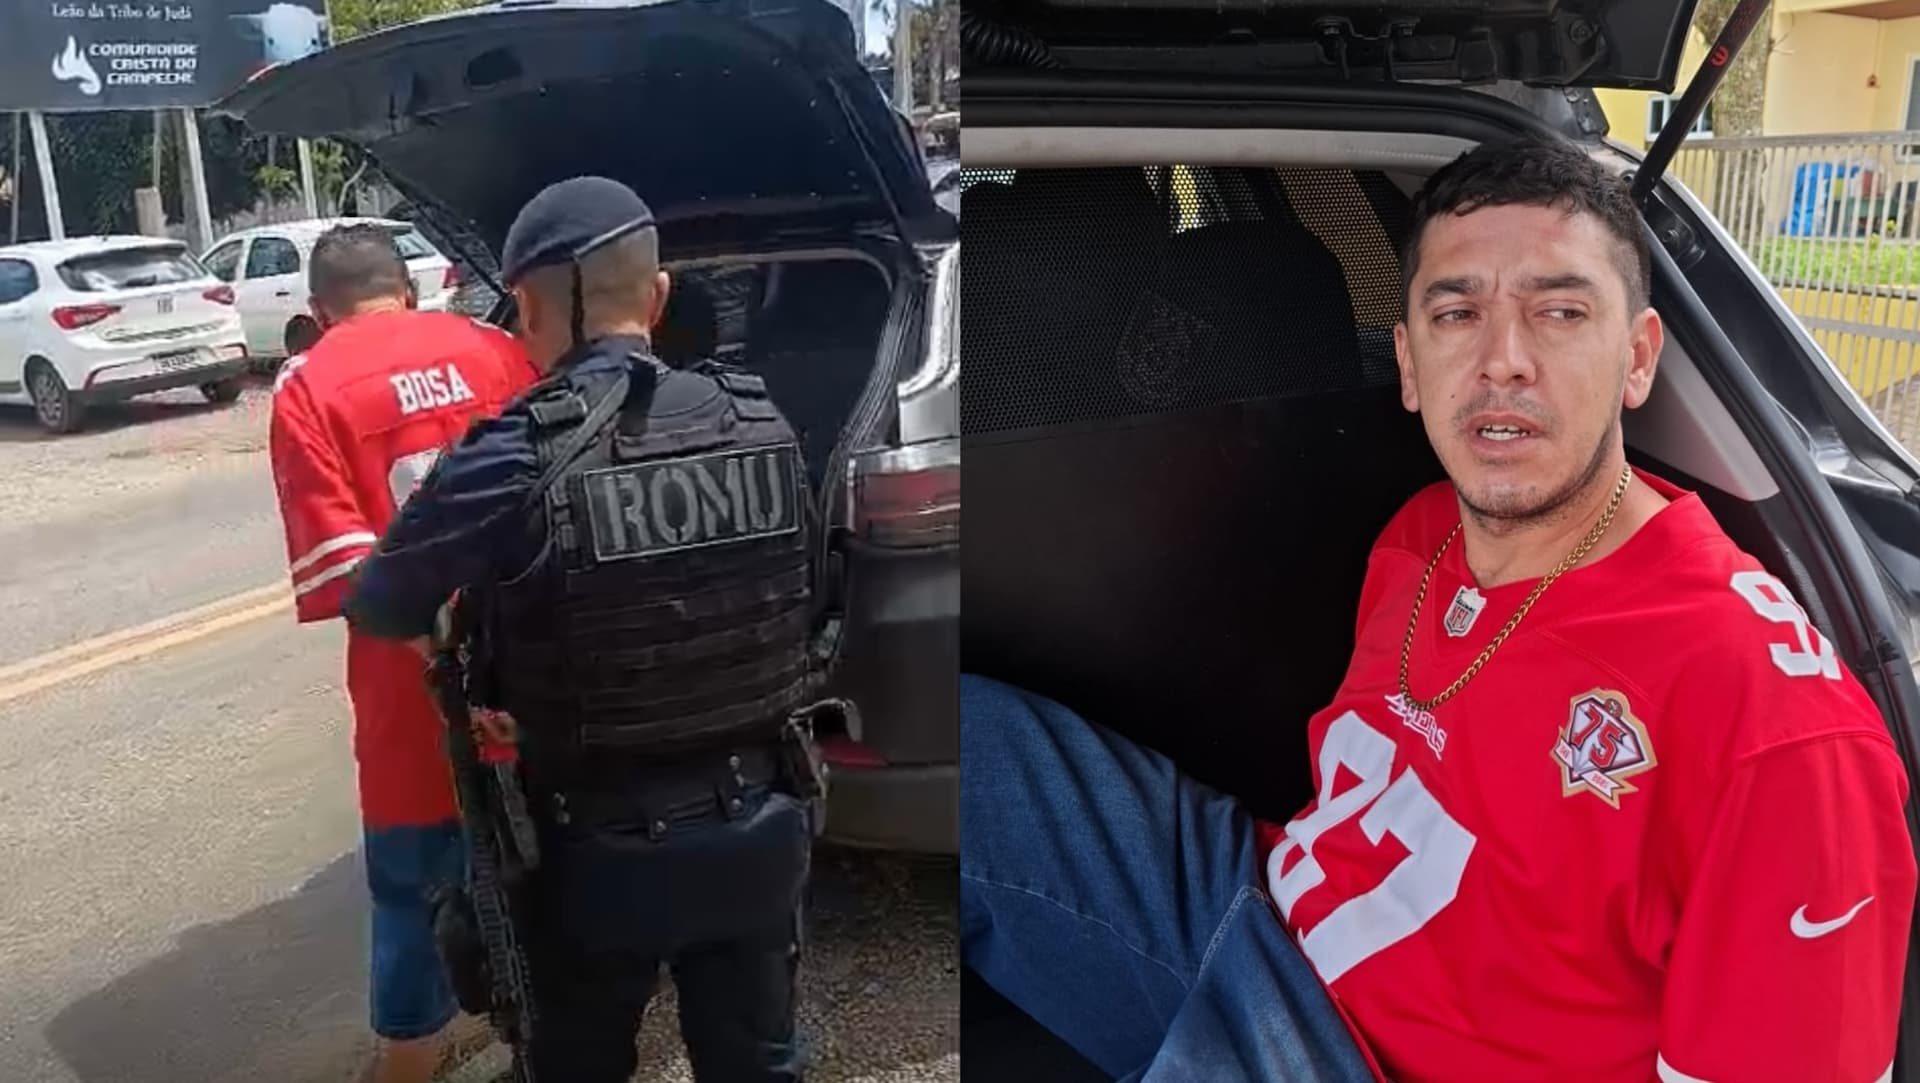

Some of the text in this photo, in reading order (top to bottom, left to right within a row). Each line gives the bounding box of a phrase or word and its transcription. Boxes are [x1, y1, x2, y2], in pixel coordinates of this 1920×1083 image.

[52, 3, 192, 21] Leão da Tribo de Judá
[90, 43, 198, 56] COMUNIDADE
[175, 58, 197, 70] DO
[107, 73, 195, 85] CAMPECHE
[389, 363, 475, 415] BOSA
[603, 454, 782, 551] ROMU
[1572, 702, 1626, 768] 75
